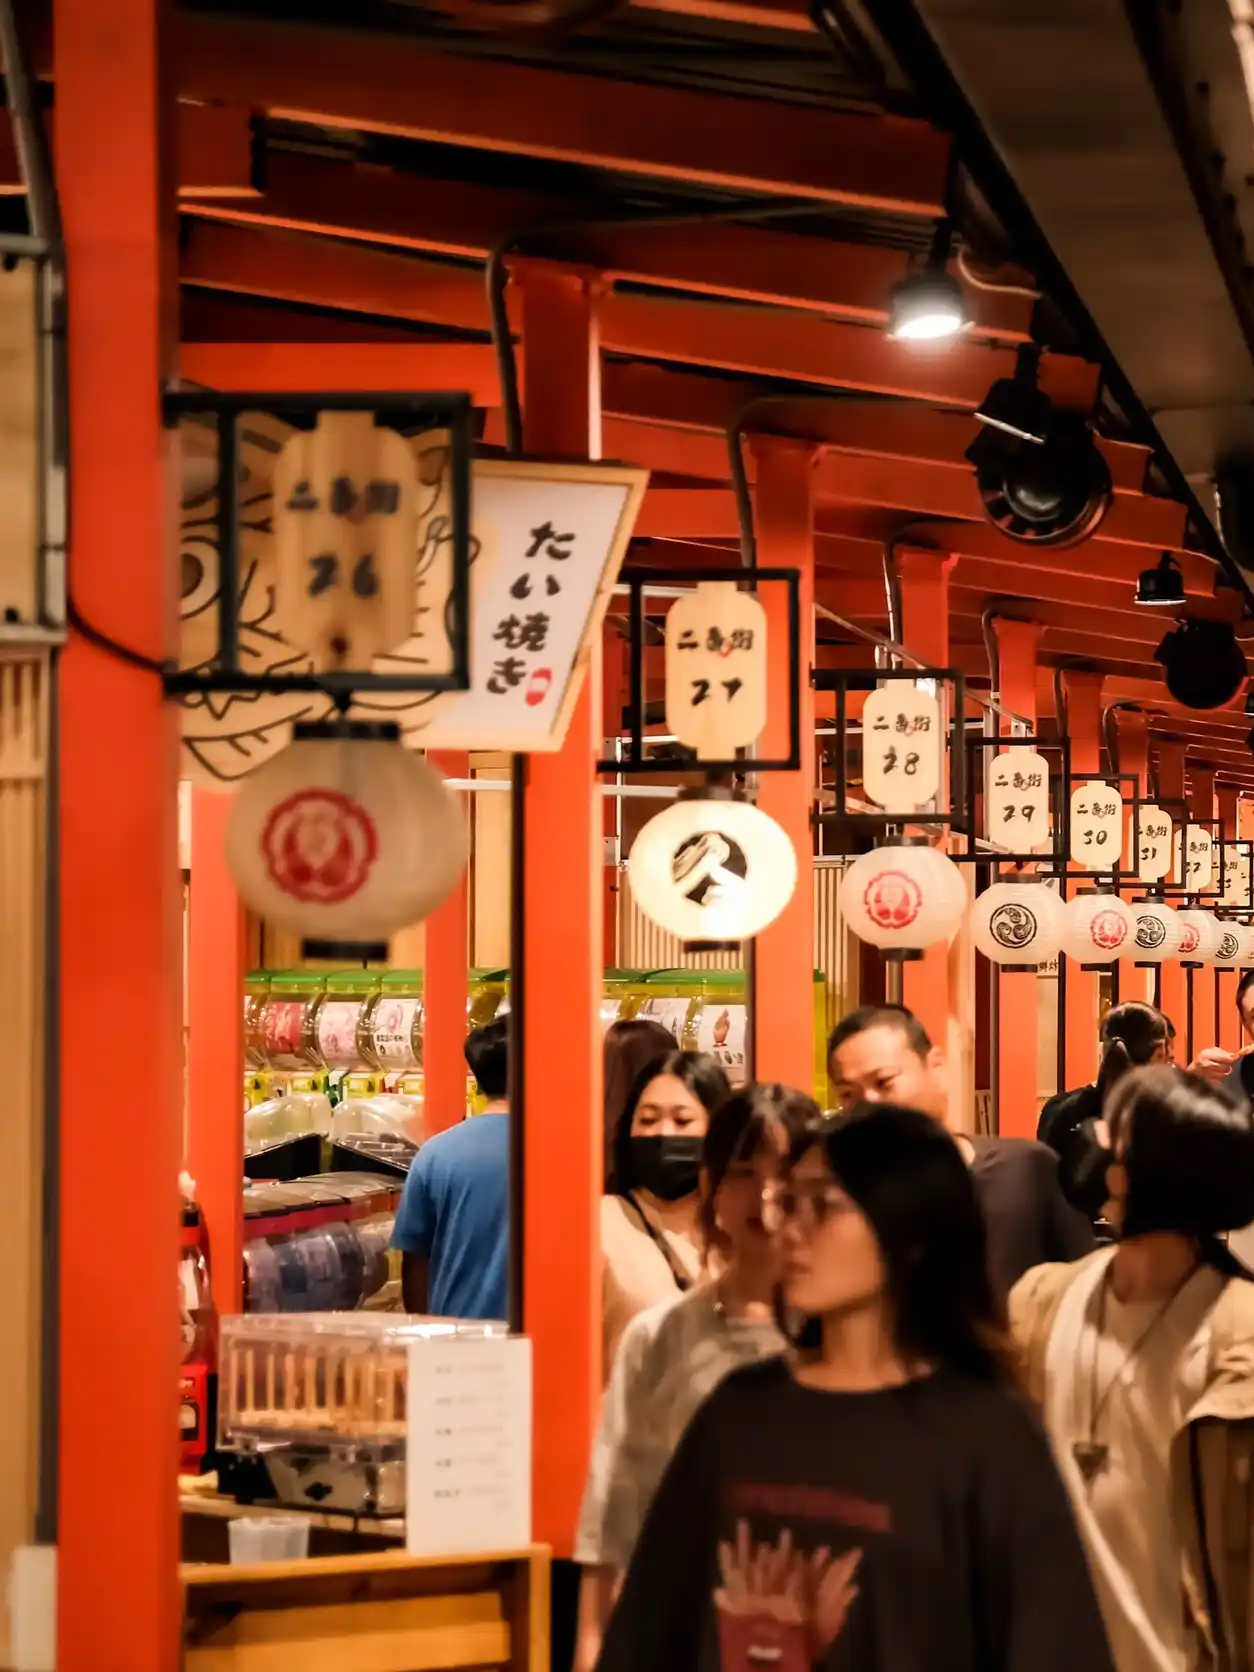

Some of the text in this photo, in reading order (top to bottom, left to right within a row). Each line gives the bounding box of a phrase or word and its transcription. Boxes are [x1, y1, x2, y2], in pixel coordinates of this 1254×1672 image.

[487, 520, 576, 694] たい焼き
[677, 626, 755, 652] 二番街
[691, 676, 743, 706] 27
[872, 712, 931, 734] 二番街
[882, 746, 921, 776] 28
[994, 771, 1042, 792] 二番街
[1002, 804, 1036, 823] 29
[1076, 802, 1117, 818] 二番街
[1211, 861, 1239, 871] 二街
